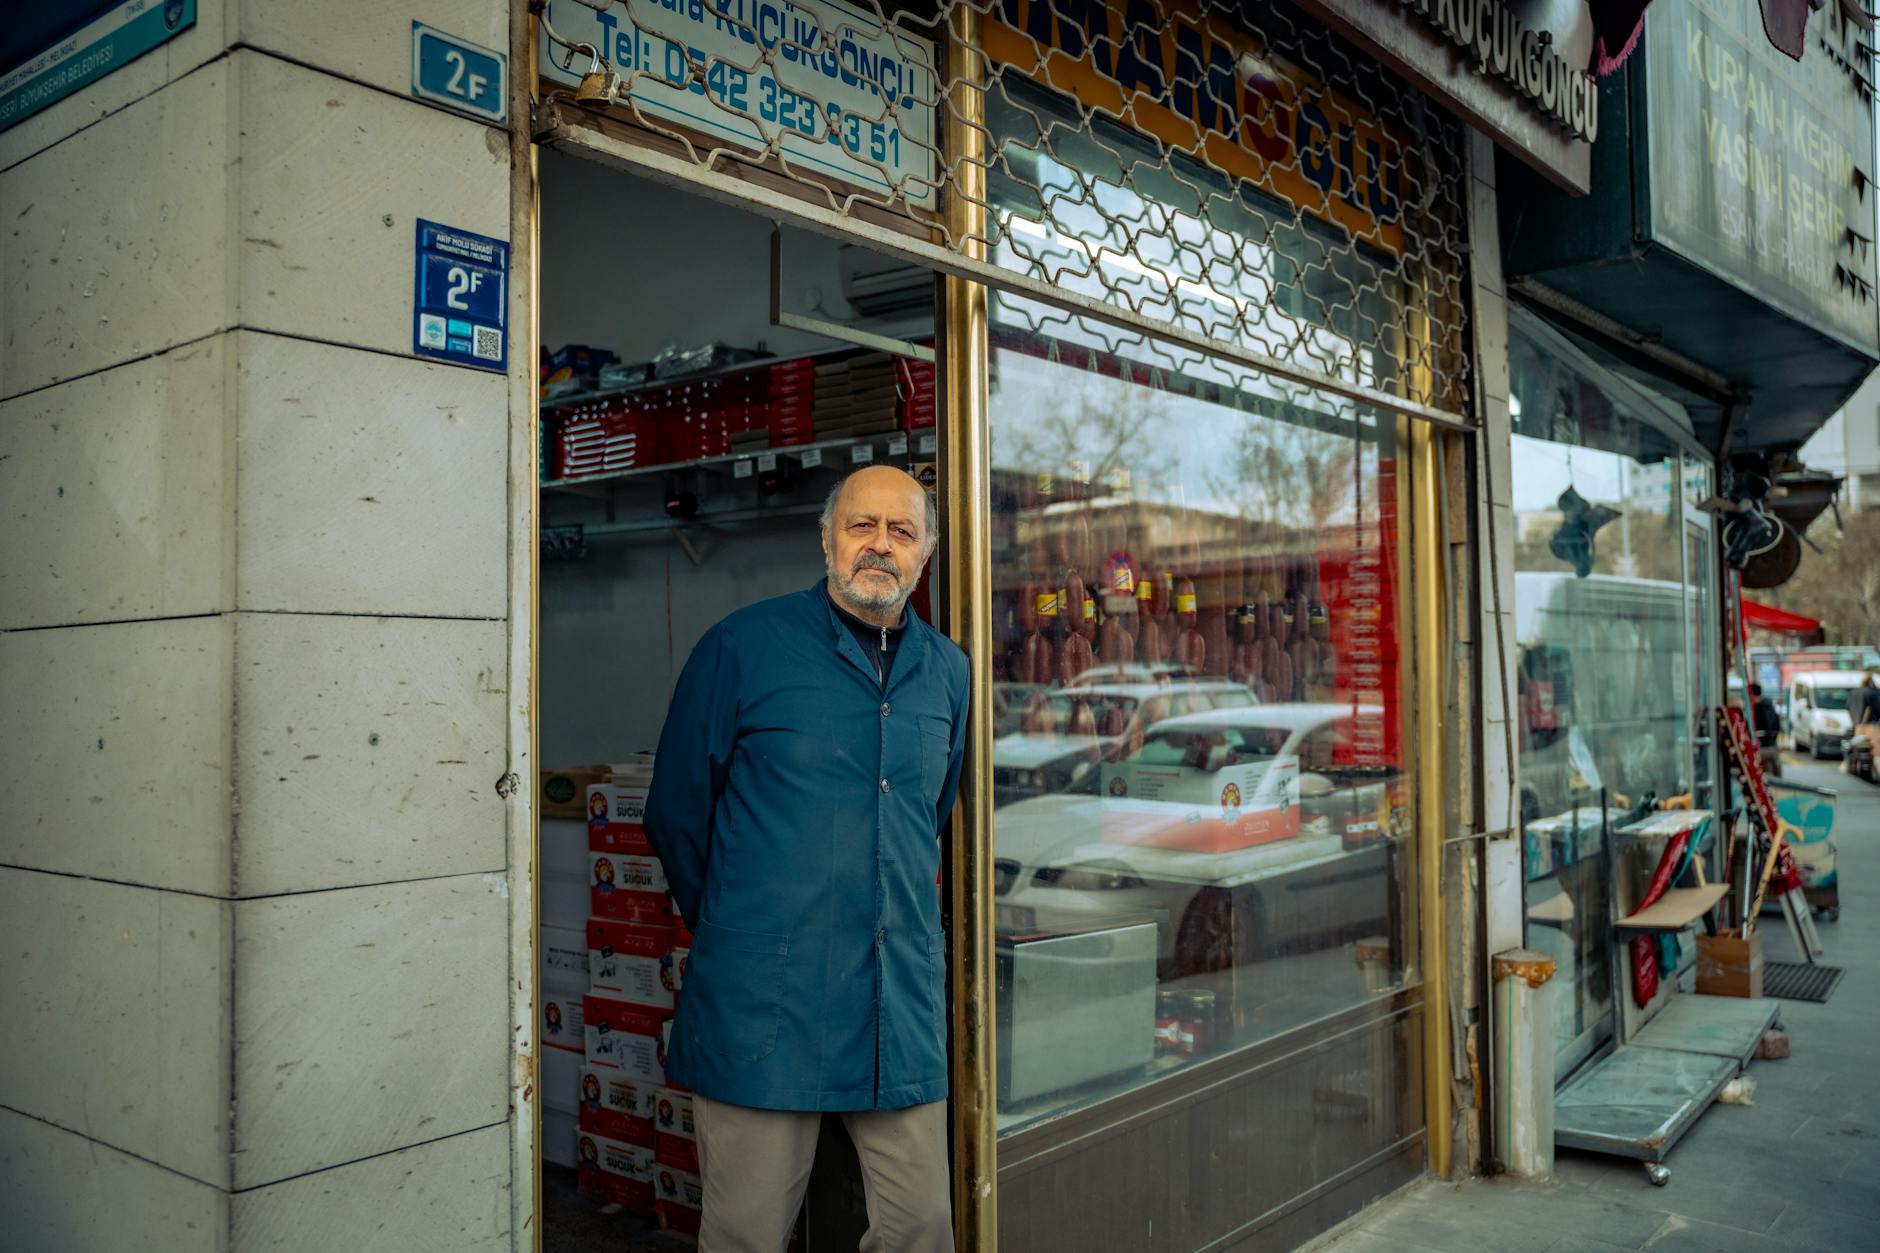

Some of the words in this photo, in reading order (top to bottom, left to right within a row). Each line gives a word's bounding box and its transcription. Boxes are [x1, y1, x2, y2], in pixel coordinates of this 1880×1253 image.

[67, 42, 113, 83] BELEDİYESİ
[596, 11, 650, 73] Tel:
[760, 76, 815, 136] 323
[870, 123, 899, 169] 51
